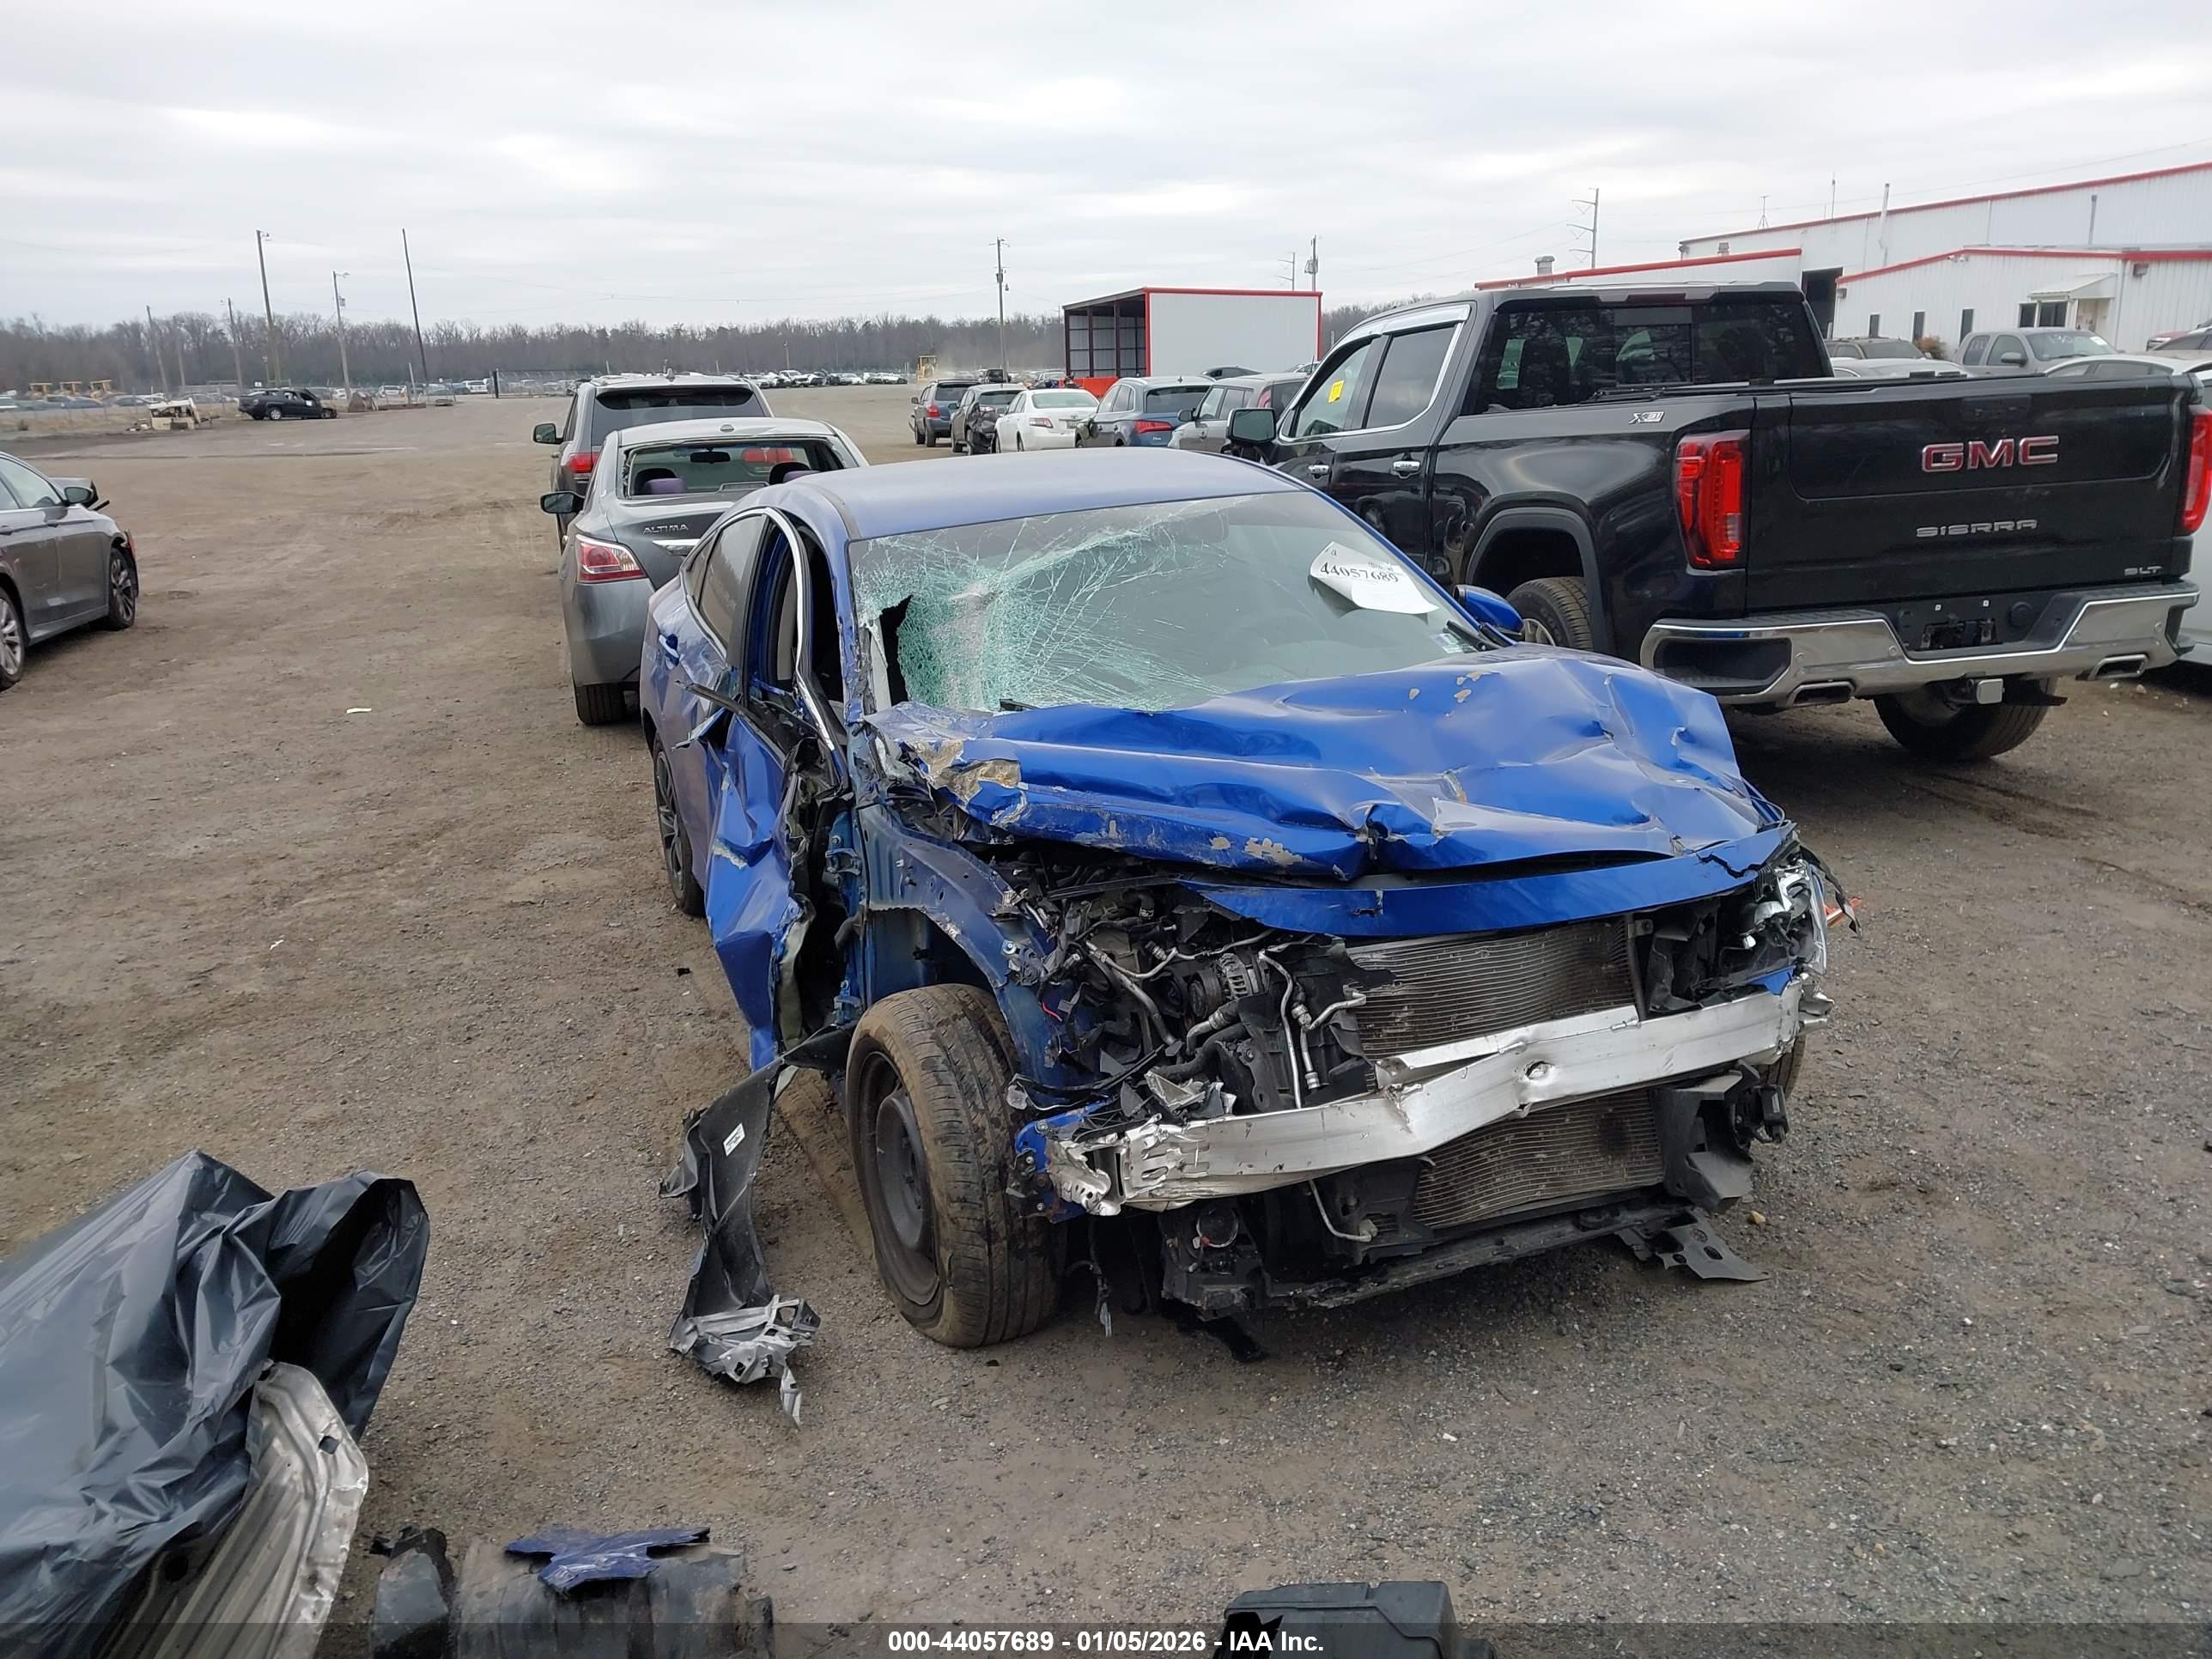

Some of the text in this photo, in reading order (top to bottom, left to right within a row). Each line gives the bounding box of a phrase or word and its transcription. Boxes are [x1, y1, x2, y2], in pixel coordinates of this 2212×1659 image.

[1922, 435, 2059, 473] GMC
[643, 524, 689, 535] ALTIMA
[1916, 519, 2038, 538] SIERRA
[1321, 562, 1399, 582] 44057689
[2124, 565, 2161, 576] SLT
